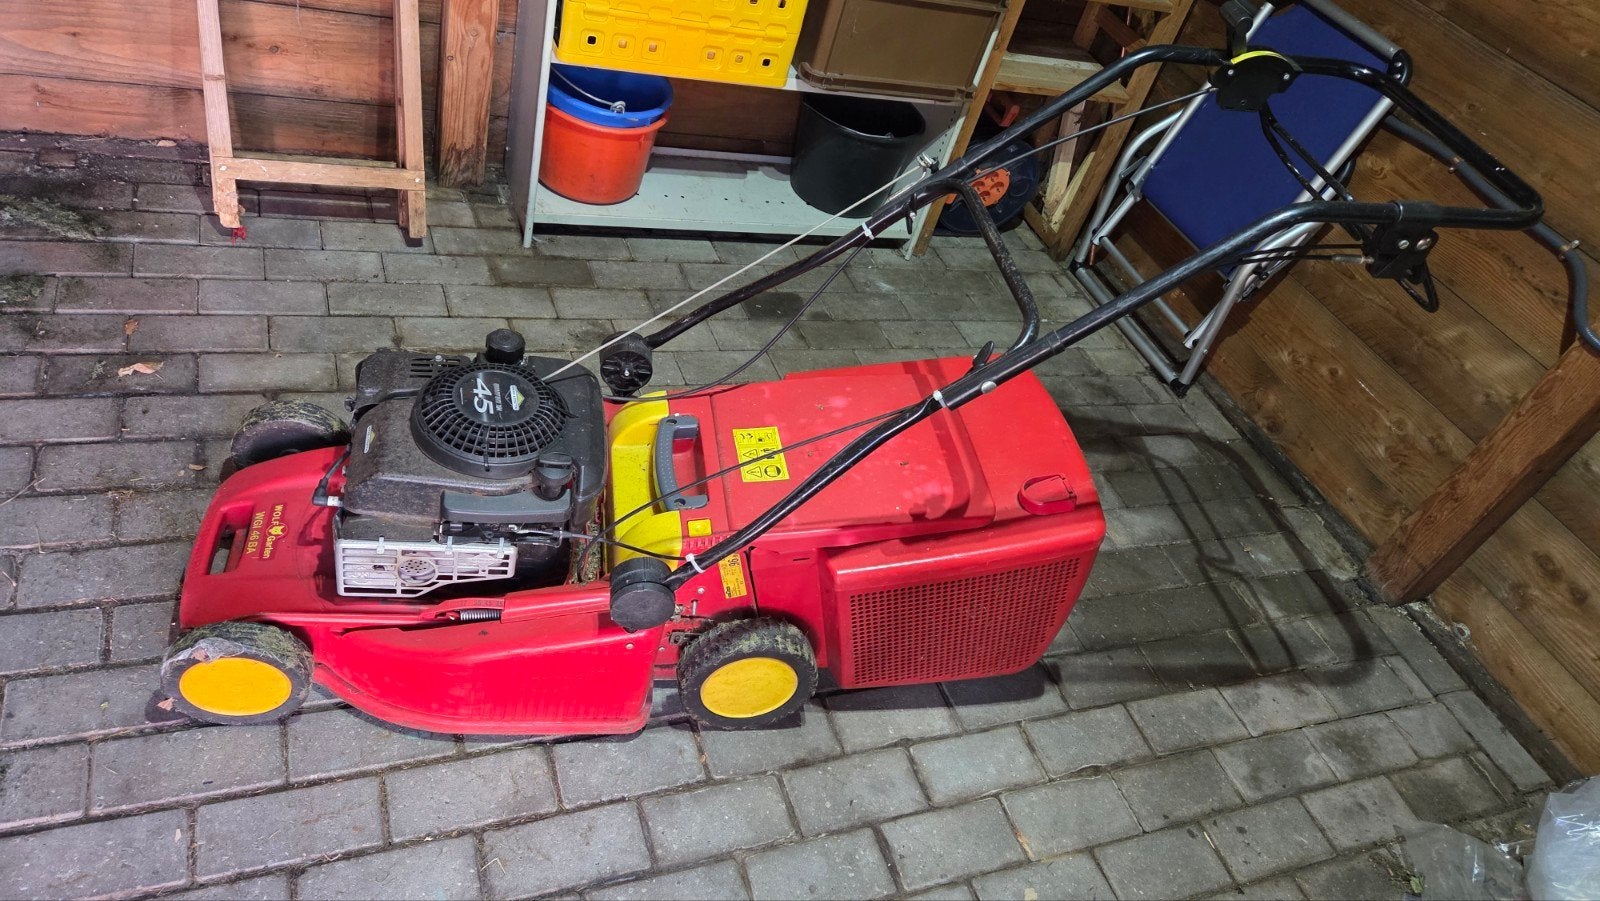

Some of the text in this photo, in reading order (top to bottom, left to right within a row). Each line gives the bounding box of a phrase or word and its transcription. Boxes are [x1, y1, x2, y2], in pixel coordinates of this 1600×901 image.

[473, 378, 494, 414] 45
[250, 530, 261, 540] 46
[262, 505, 283, 558] WOLF Garten
[246, 542, 258, 554] BA
